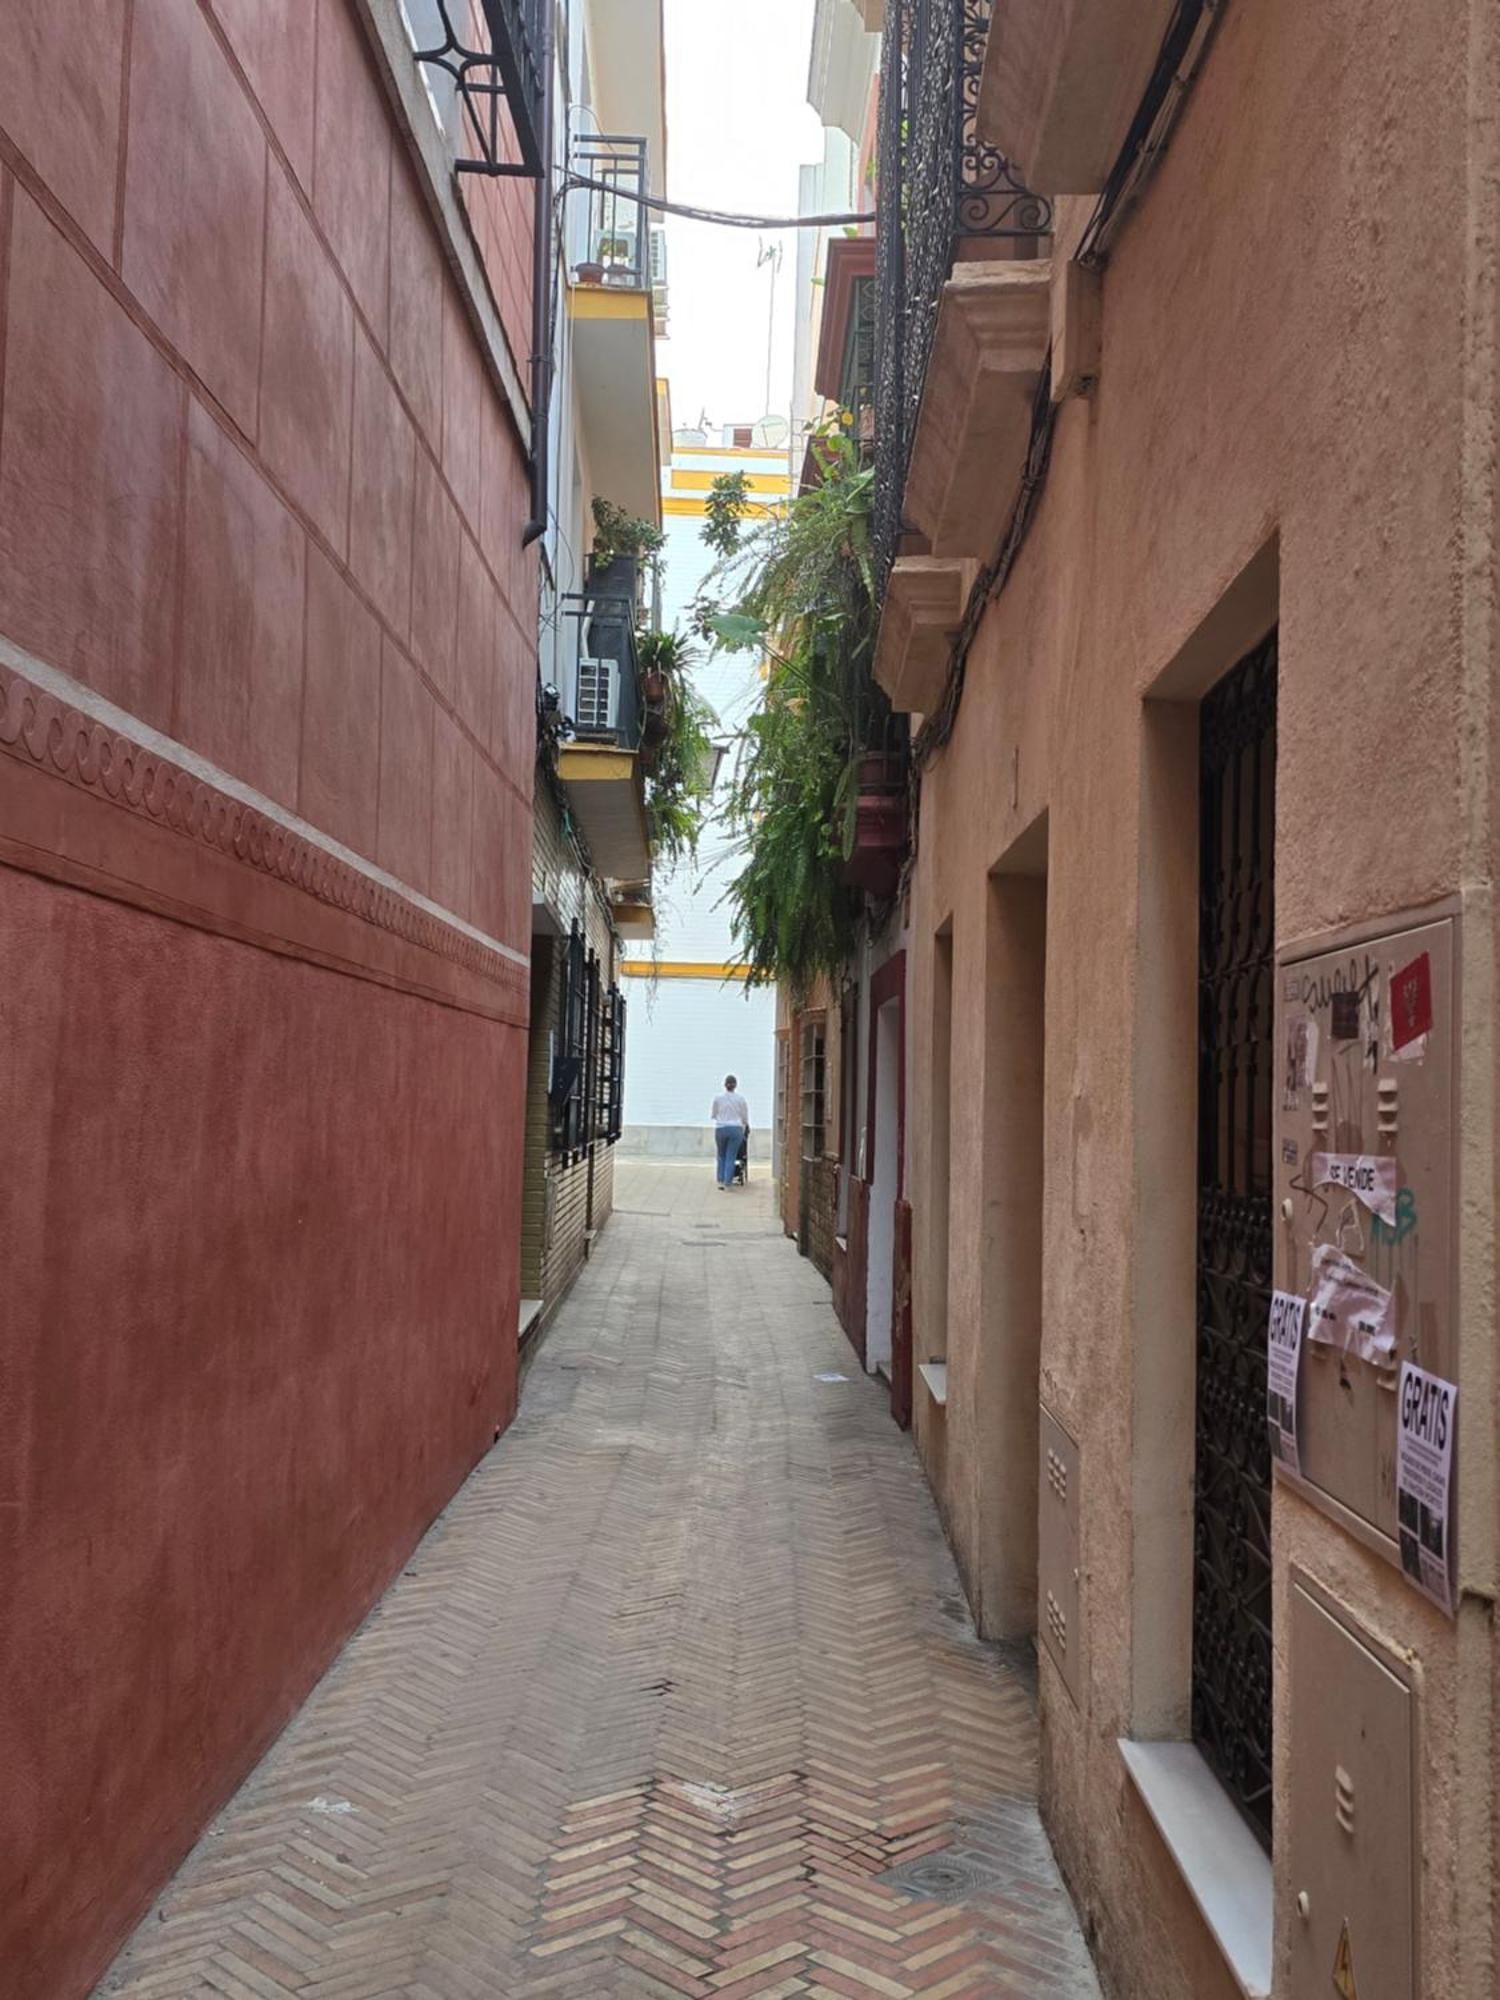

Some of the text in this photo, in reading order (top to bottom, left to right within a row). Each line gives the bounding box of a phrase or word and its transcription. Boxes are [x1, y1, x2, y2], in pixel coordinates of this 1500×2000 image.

[1343, 1166, 1375, 1191] VENDE
[1271, 1297, 1301, 1350] GRATIS
[1402, 1372, 1449, 1450] GRATIS
